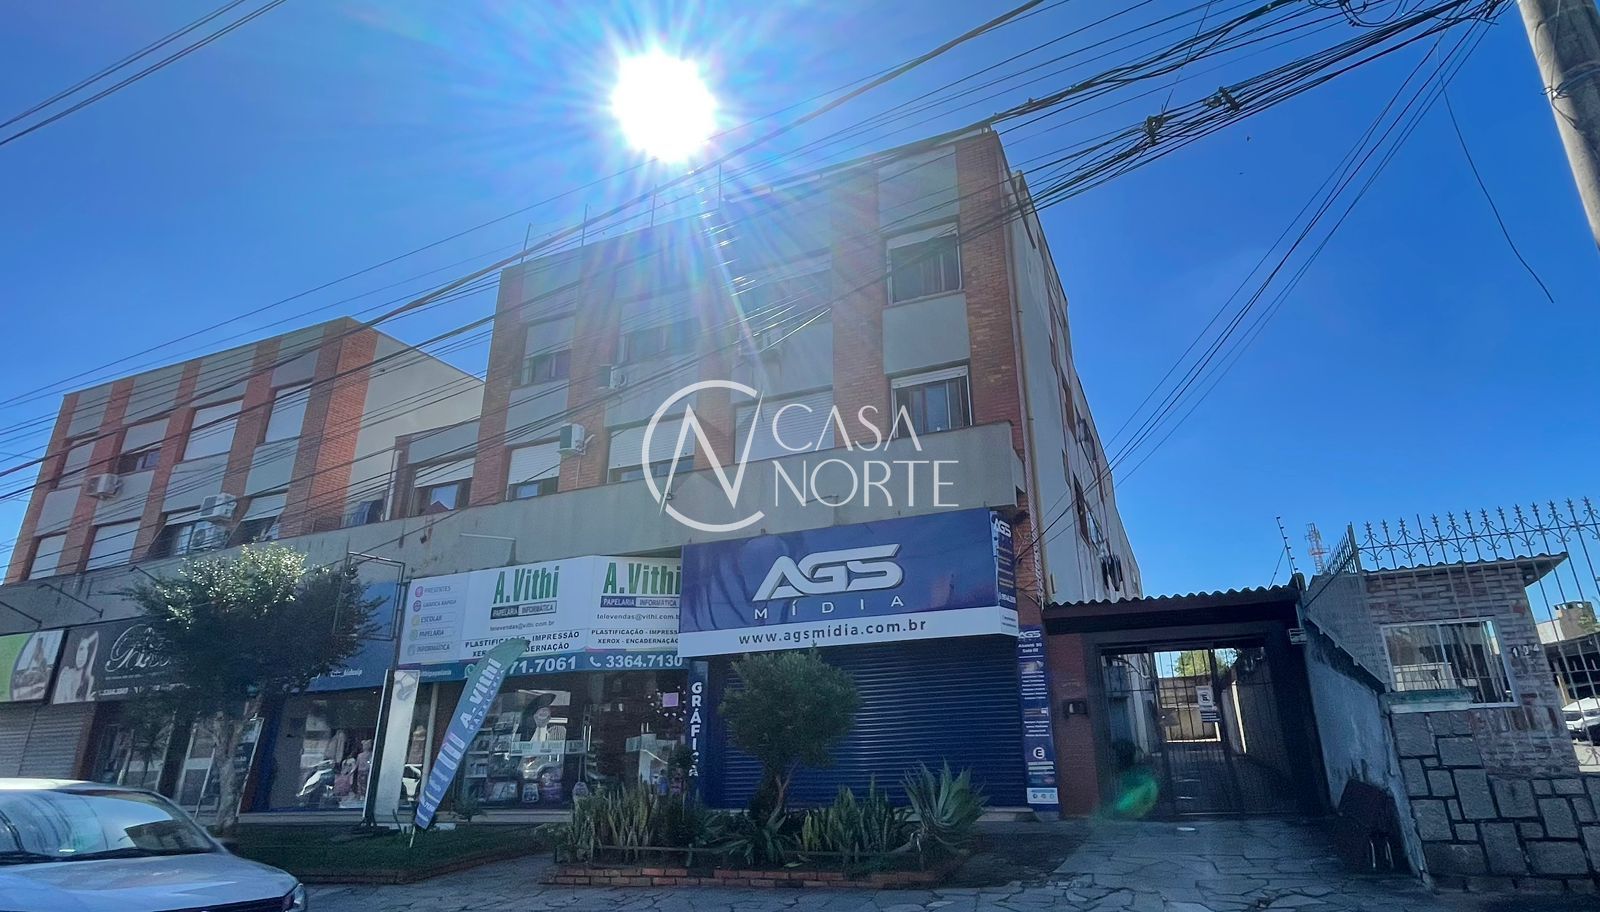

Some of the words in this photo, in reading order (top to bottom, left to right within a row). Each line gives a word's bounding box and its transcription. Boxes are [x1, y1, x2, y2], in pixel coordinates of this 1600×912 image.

[493, 565, 560, 605] A.Vithi
[603, 562, 682, 595] A.Vithi
[752, 543, 903, 602] AGS
[754, 595, 904, 621] MÍDIA
[531, 631, 580, 642] IMPRESSÃO
[738, 618, 927, 645] www.agsmidia.com.br
[526, 642, 570, 653] DERNAÇÃO
[605, 654, 683, 668] 3364.7130
